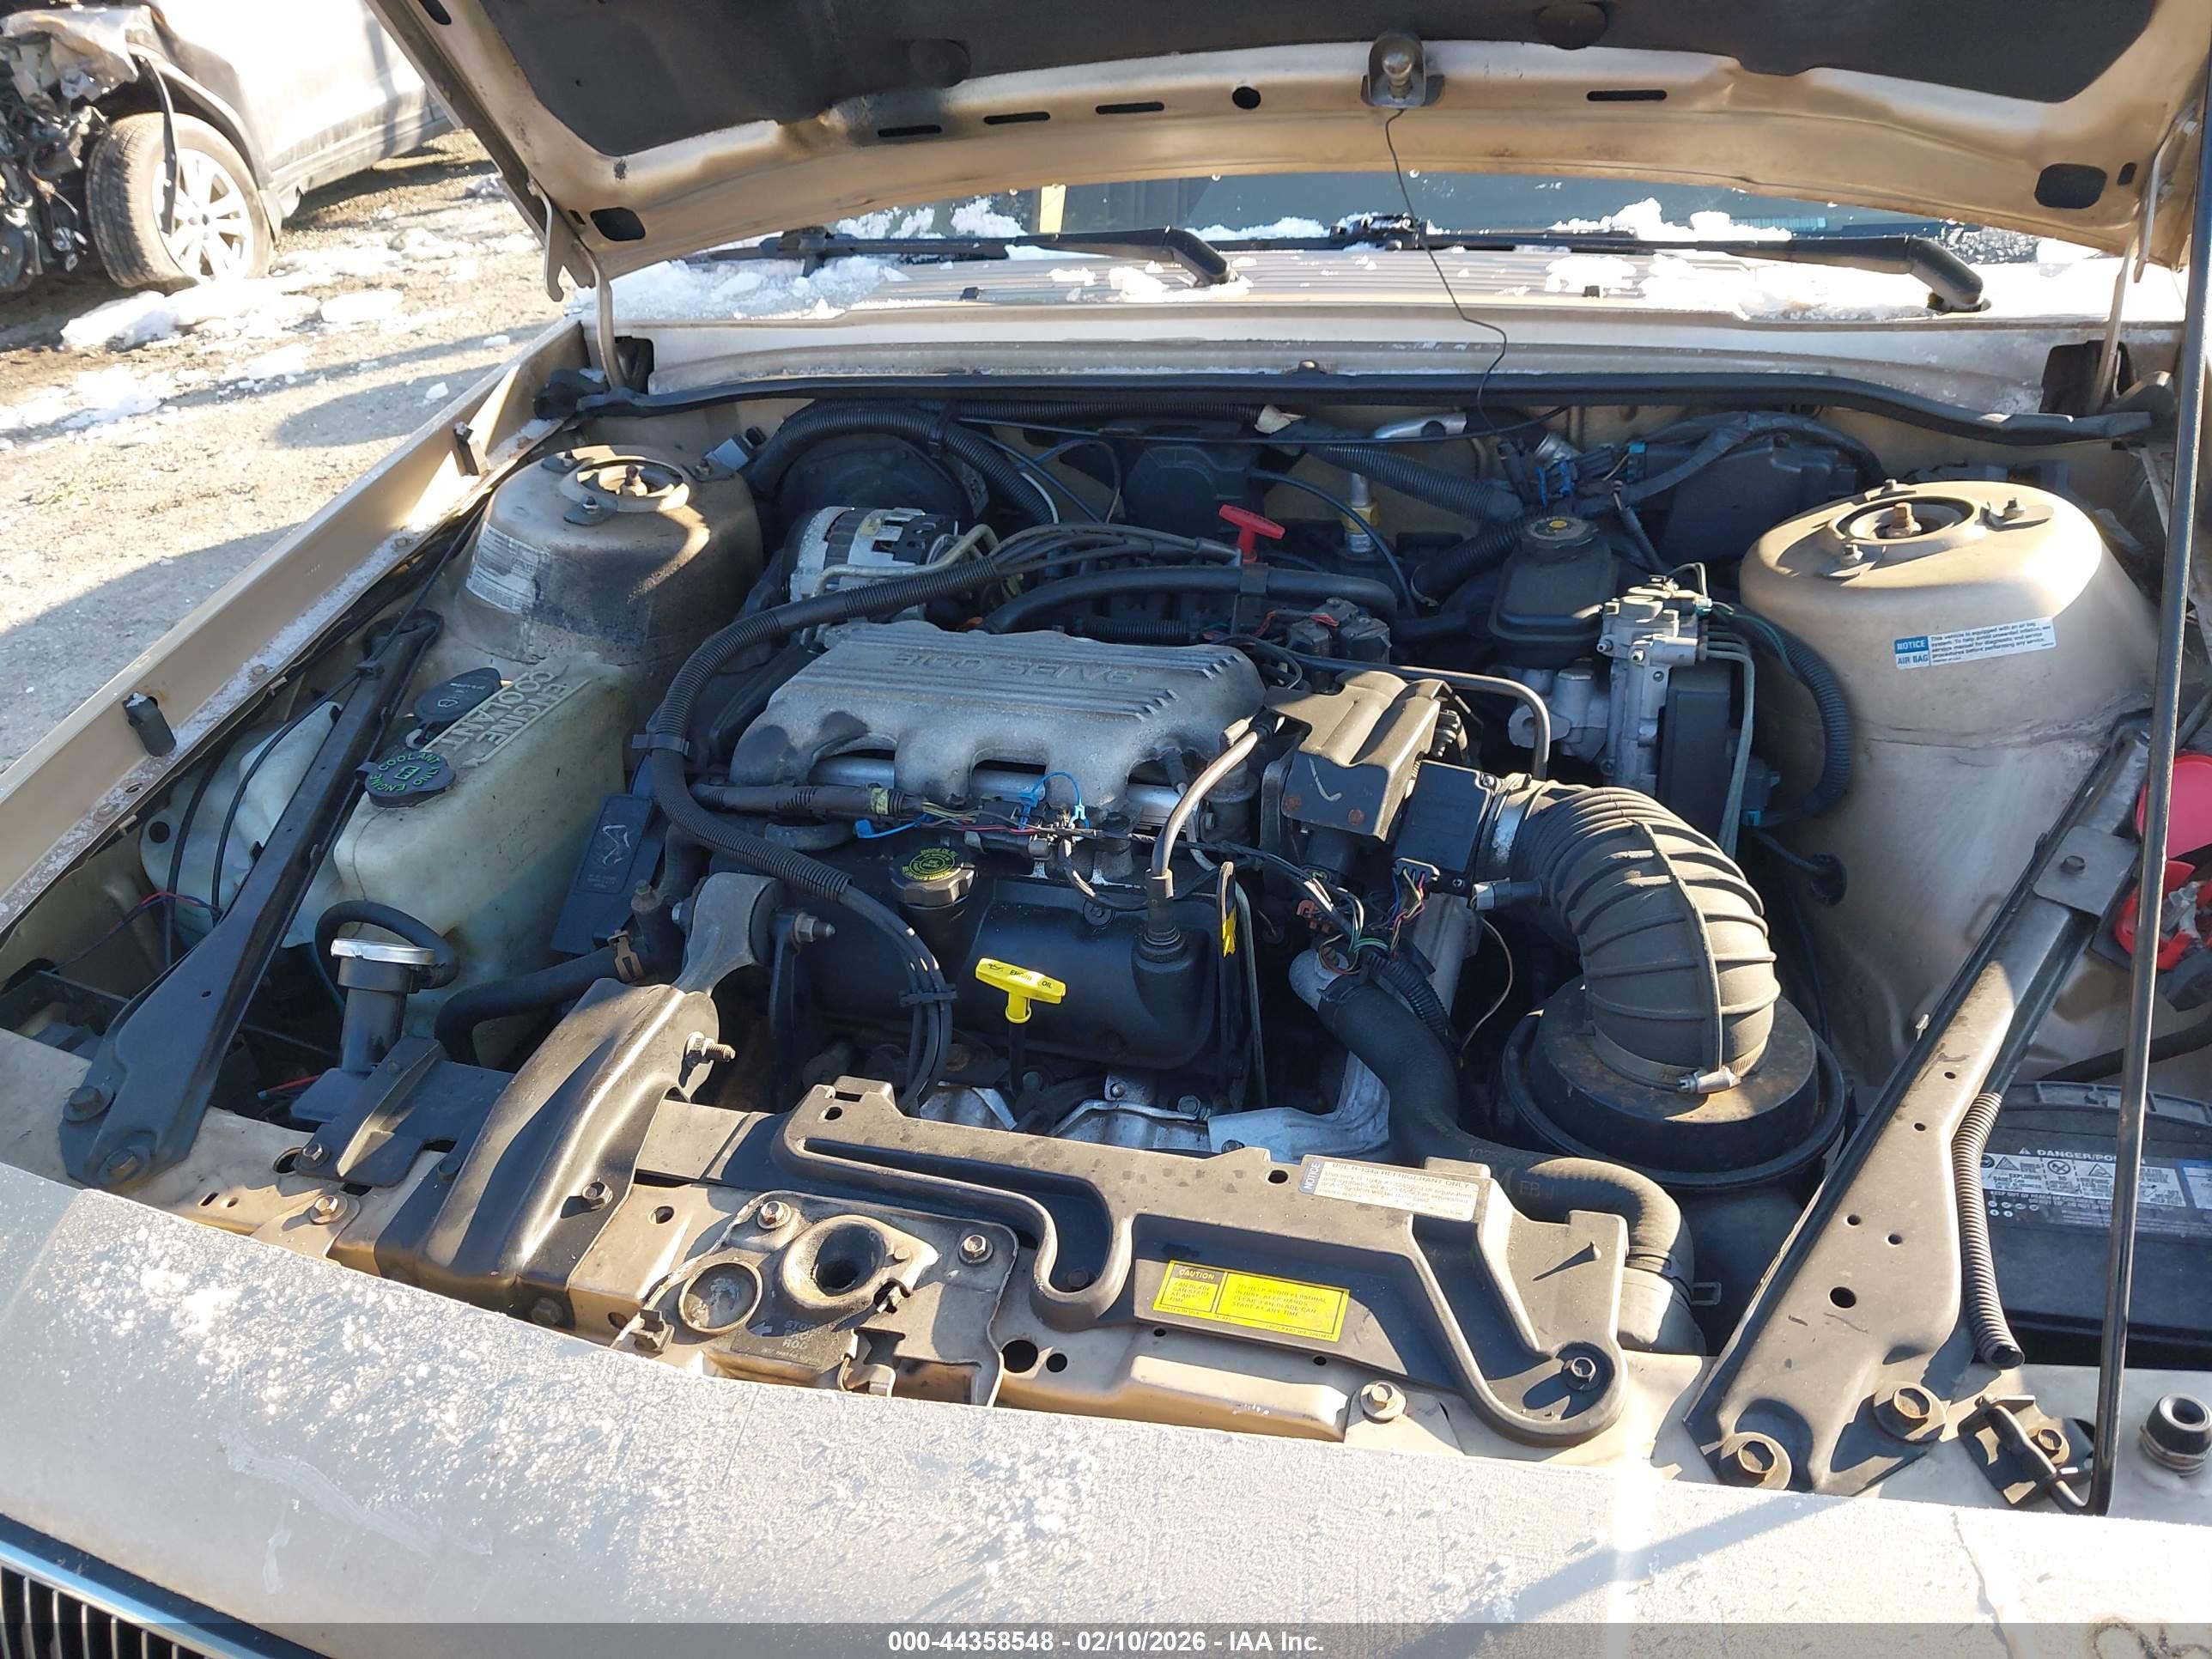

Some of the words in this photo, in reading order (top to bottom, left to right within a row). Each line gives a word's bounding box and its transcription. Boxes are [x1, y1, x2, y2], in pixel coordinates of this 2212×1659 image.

[1896, 639, 1926, 651] NOTICE
[1897, 654, 1911, 665] AIR
[1912, 653, 1929, 664] BAG
[439, 671, 555, 751] COOLANT
[475, 684, 571, 745] ENGINE
[378, 752, 440, 770] COOLANT
[370, 774, 406, 792] ENGINE
[413, 766, 441, 786] ONLY
[1042, 980, 1053, 988] OIL
[1304, 1161, 1322, 1191] NOTICE
[1445, 1180, 1470, 1188] ONLY
[1178, 1268, 1215, 1280] CAUTION
